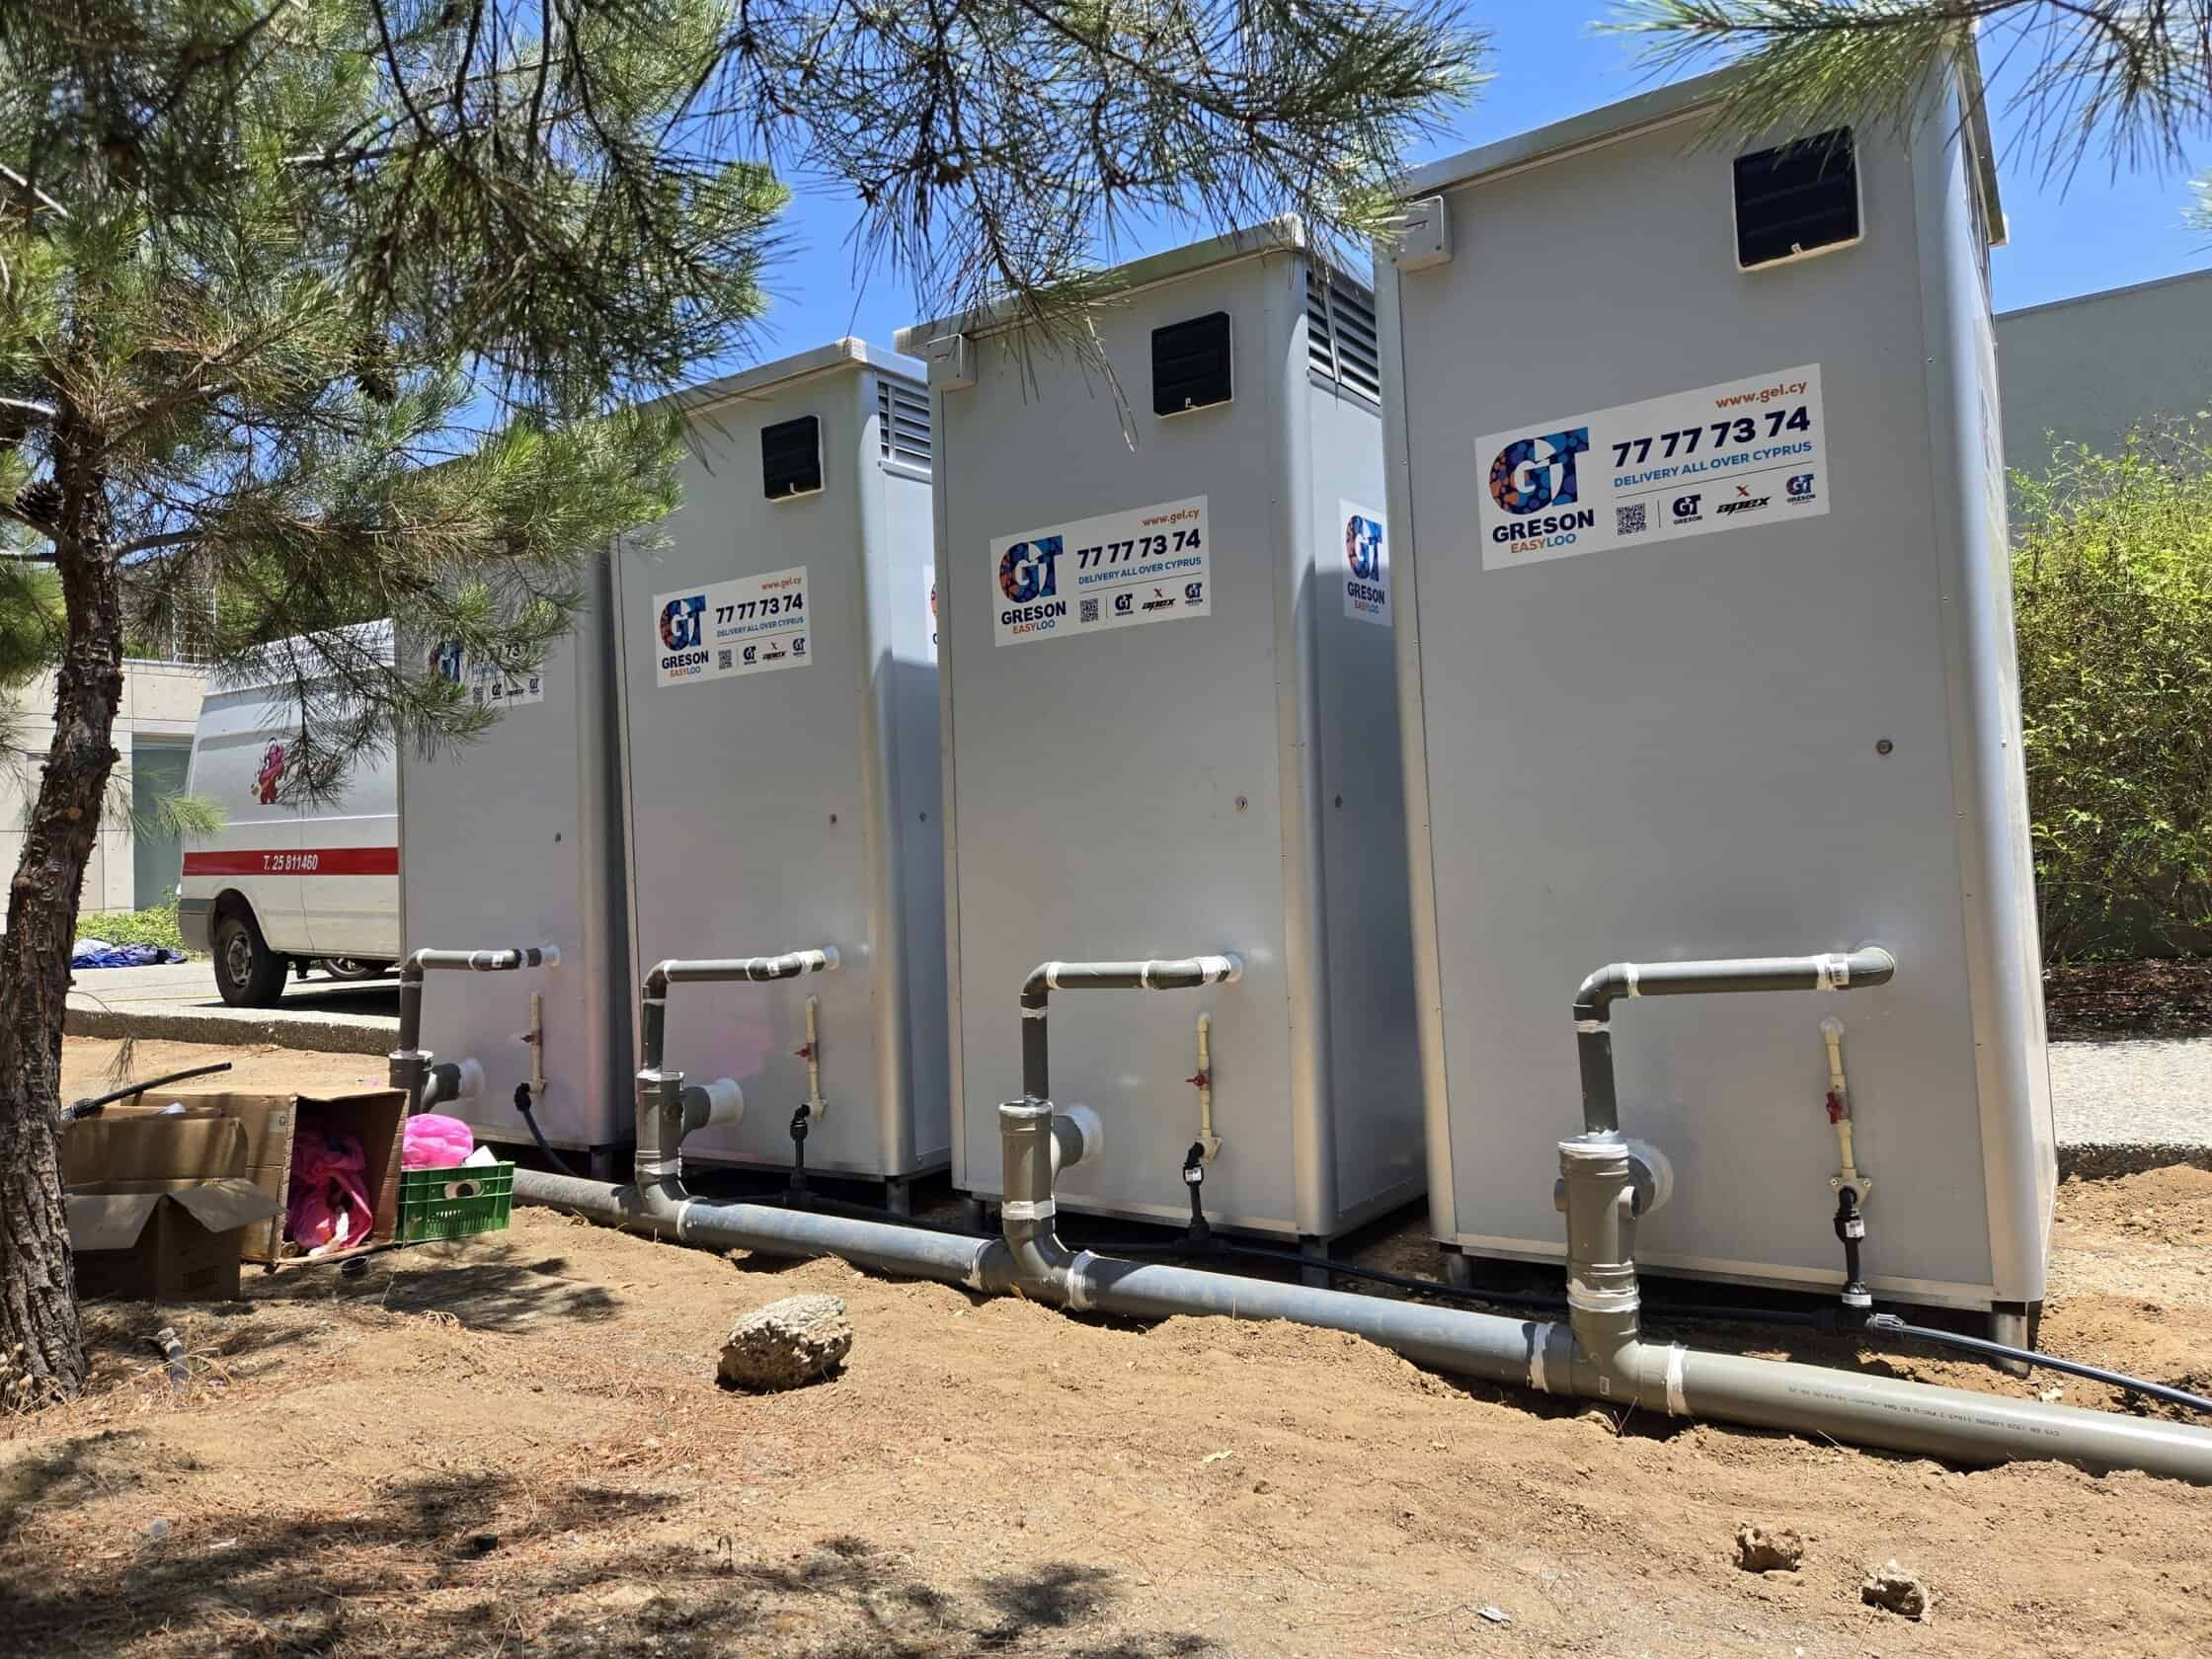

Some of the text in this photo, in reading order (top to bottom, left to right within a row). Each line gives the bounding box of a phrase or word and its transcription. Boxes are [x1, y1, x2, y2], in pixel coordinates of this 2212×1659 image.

[1715, 381, 1808, 409] www.gel.cy
[1613, 406, 1811, 468] 77 77 73 74
[1489, 426, 1591, 515] GT
[1614, 441, 1812, 489] DELIVERY ALL OVER CYPRUS
[1142, 509, 1200, 526] www.gel.cy
[1673, 494, 1701, 517] GT
[1492, 509, 1595, 544] GRESON
[1077, 528, 1201, 569] 77 77 73 74
[1510, 532, 1577, 554] EASYLOO
[999, 534, 1064, 603] GT
[1078, 556, 1202, 585] DELIVERY ALL OVER CYPRUS
[1347, 581, 1385, 605] GRESON
[660, 594, 707, 652] GT
[716, 592, 804, 625] 77 77 73 74
[1001, 600, 1066, 625] GRESON
[662, 650, 709, 670] GRESON
[272, 854, 284, 870] 25
